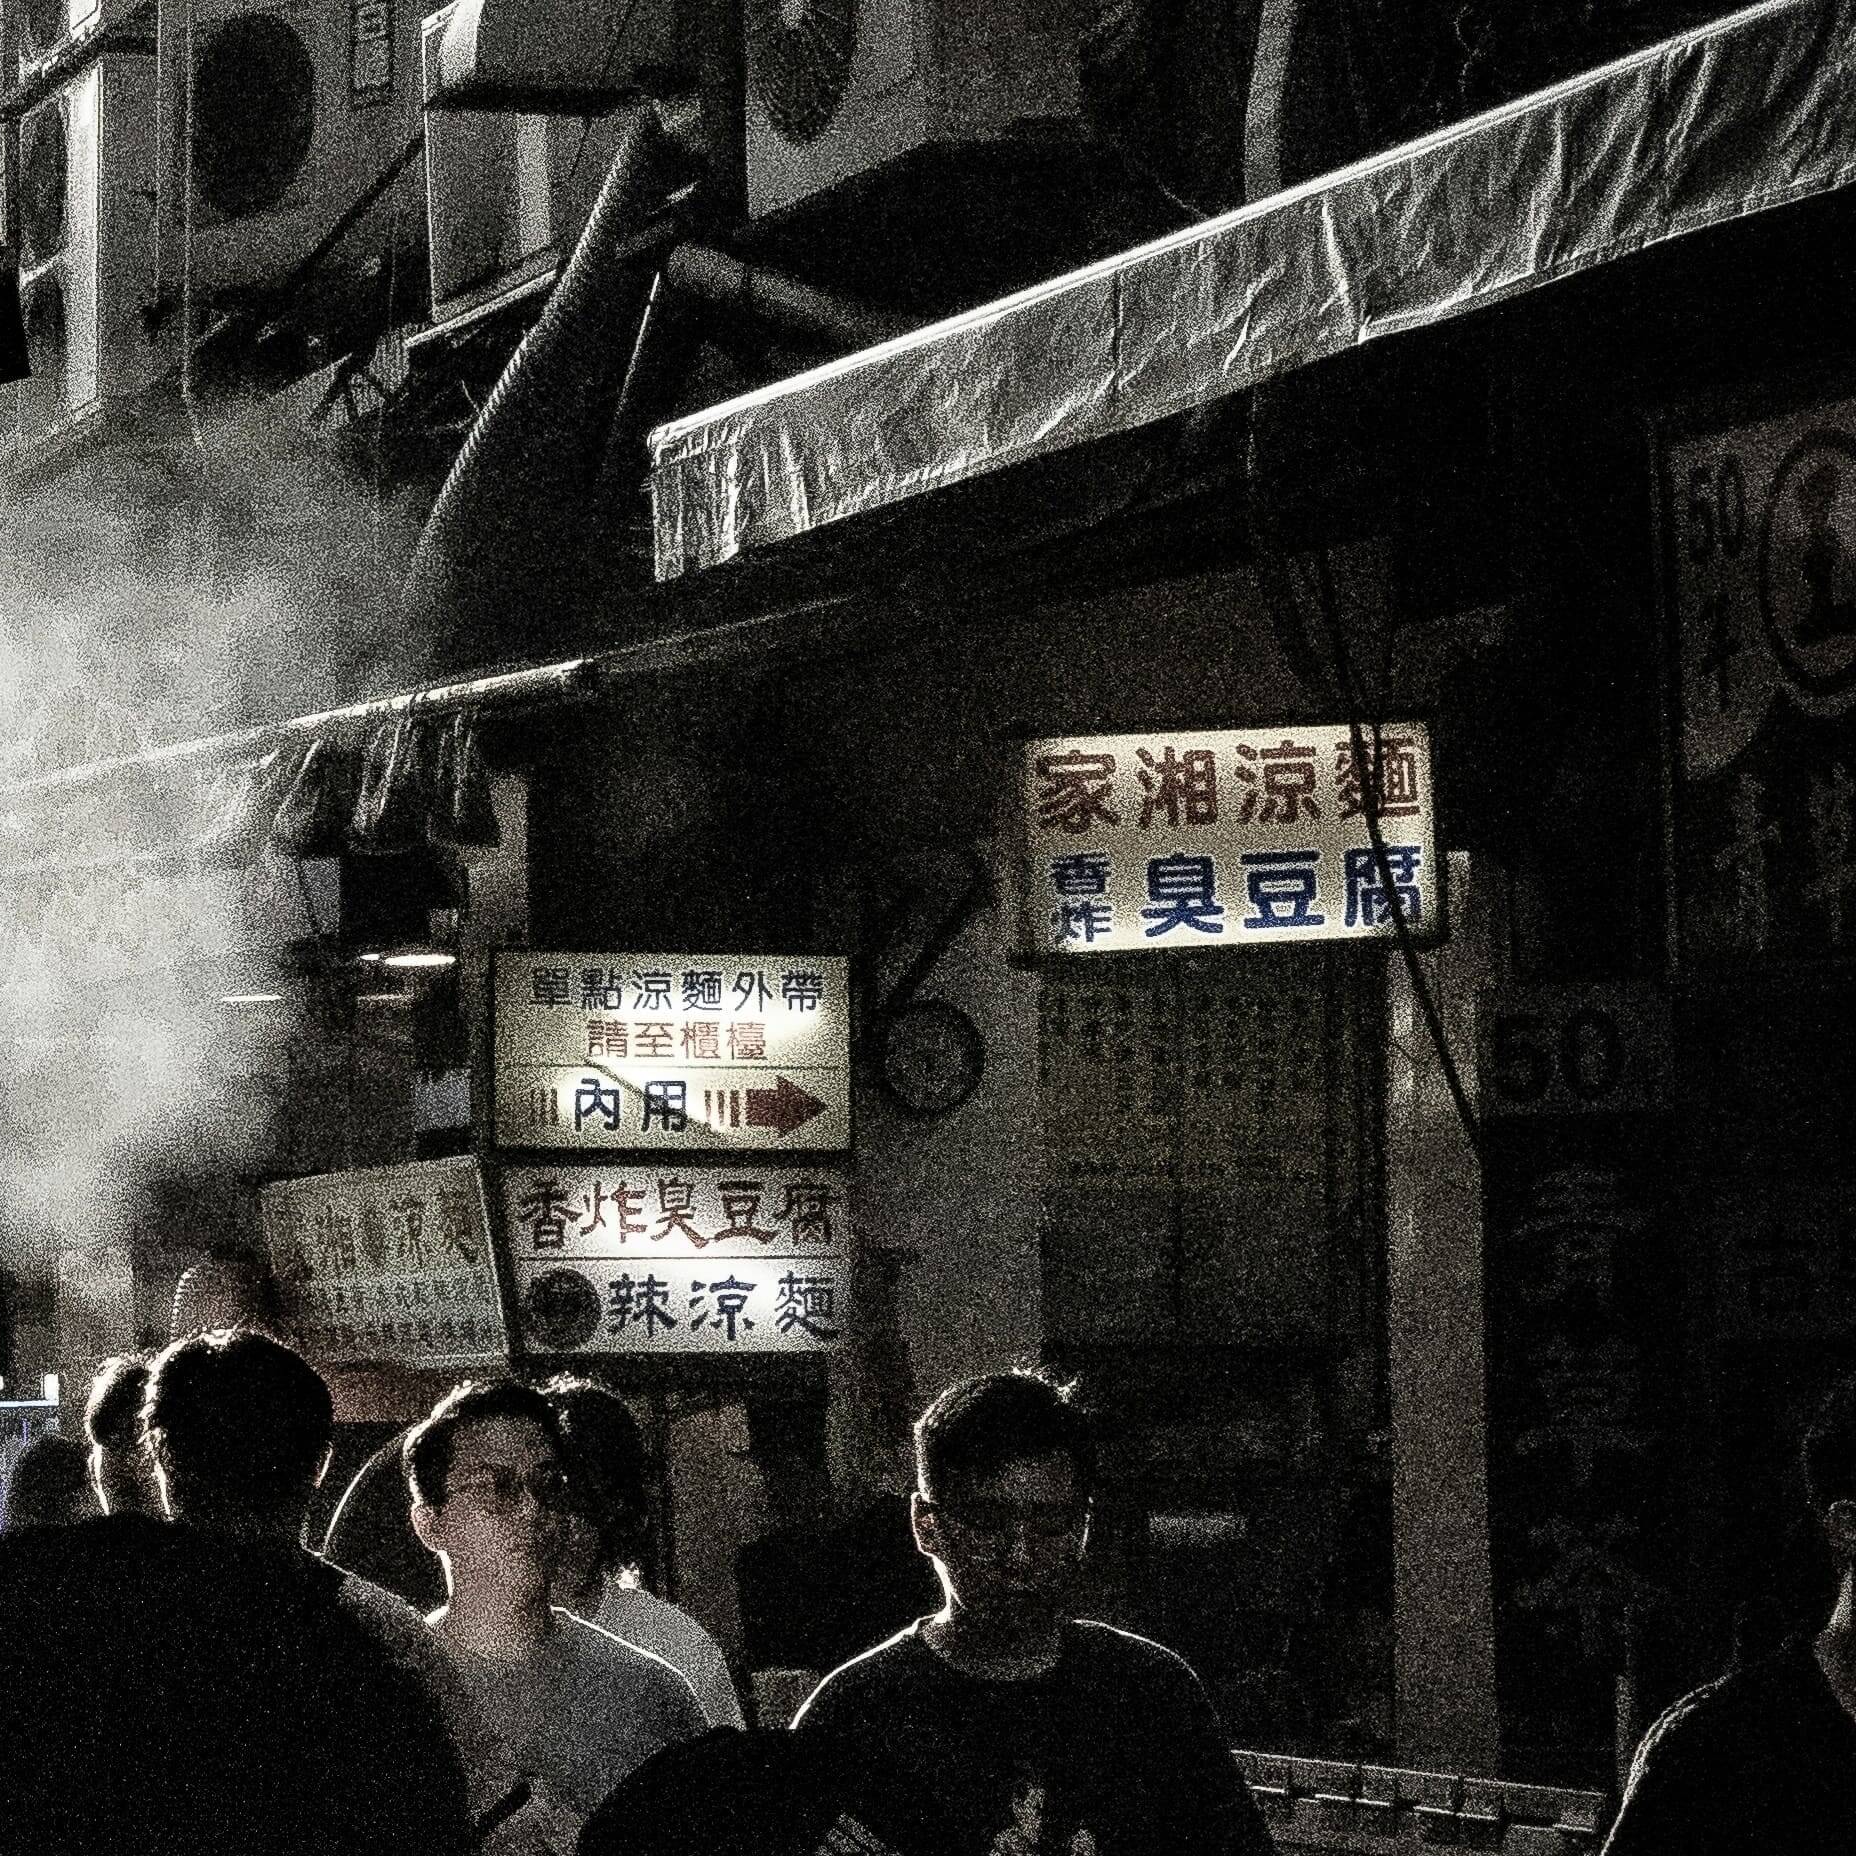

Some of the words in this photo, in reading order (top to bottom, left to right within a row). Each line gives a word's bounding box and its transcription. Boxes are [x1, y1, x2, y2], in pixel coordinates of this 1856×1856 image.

[1034, 737, 1422, 834] 家湘涼麵
[529, 966, 825, 1013] 單點涼麵外帶
[518, 1175, 843, 1251] 香炸臭豆腐
[606, 1268, 840, 1343] 辣涼麵
